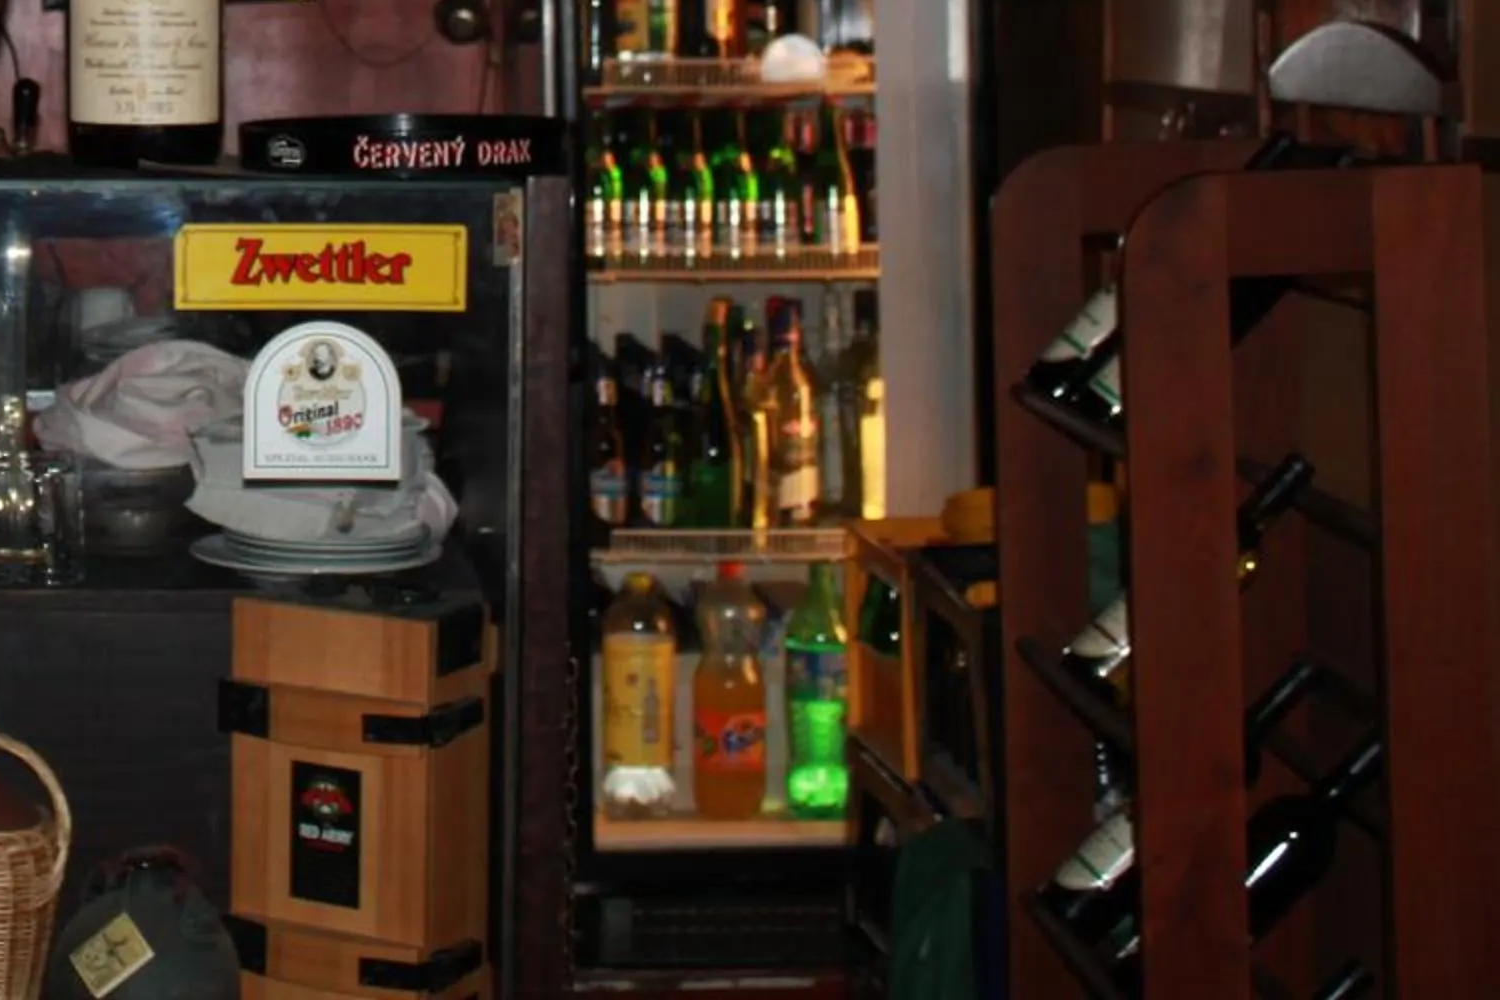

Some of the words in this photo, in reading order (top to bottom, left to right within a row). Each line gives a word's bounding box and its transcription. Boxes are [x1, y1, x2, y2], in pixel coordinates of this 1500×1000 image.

[353, 135, 467, 168] ČERVENÝ
[230, 237, 412, 286] Zwettler
[278, 399, 340, 428] Original
